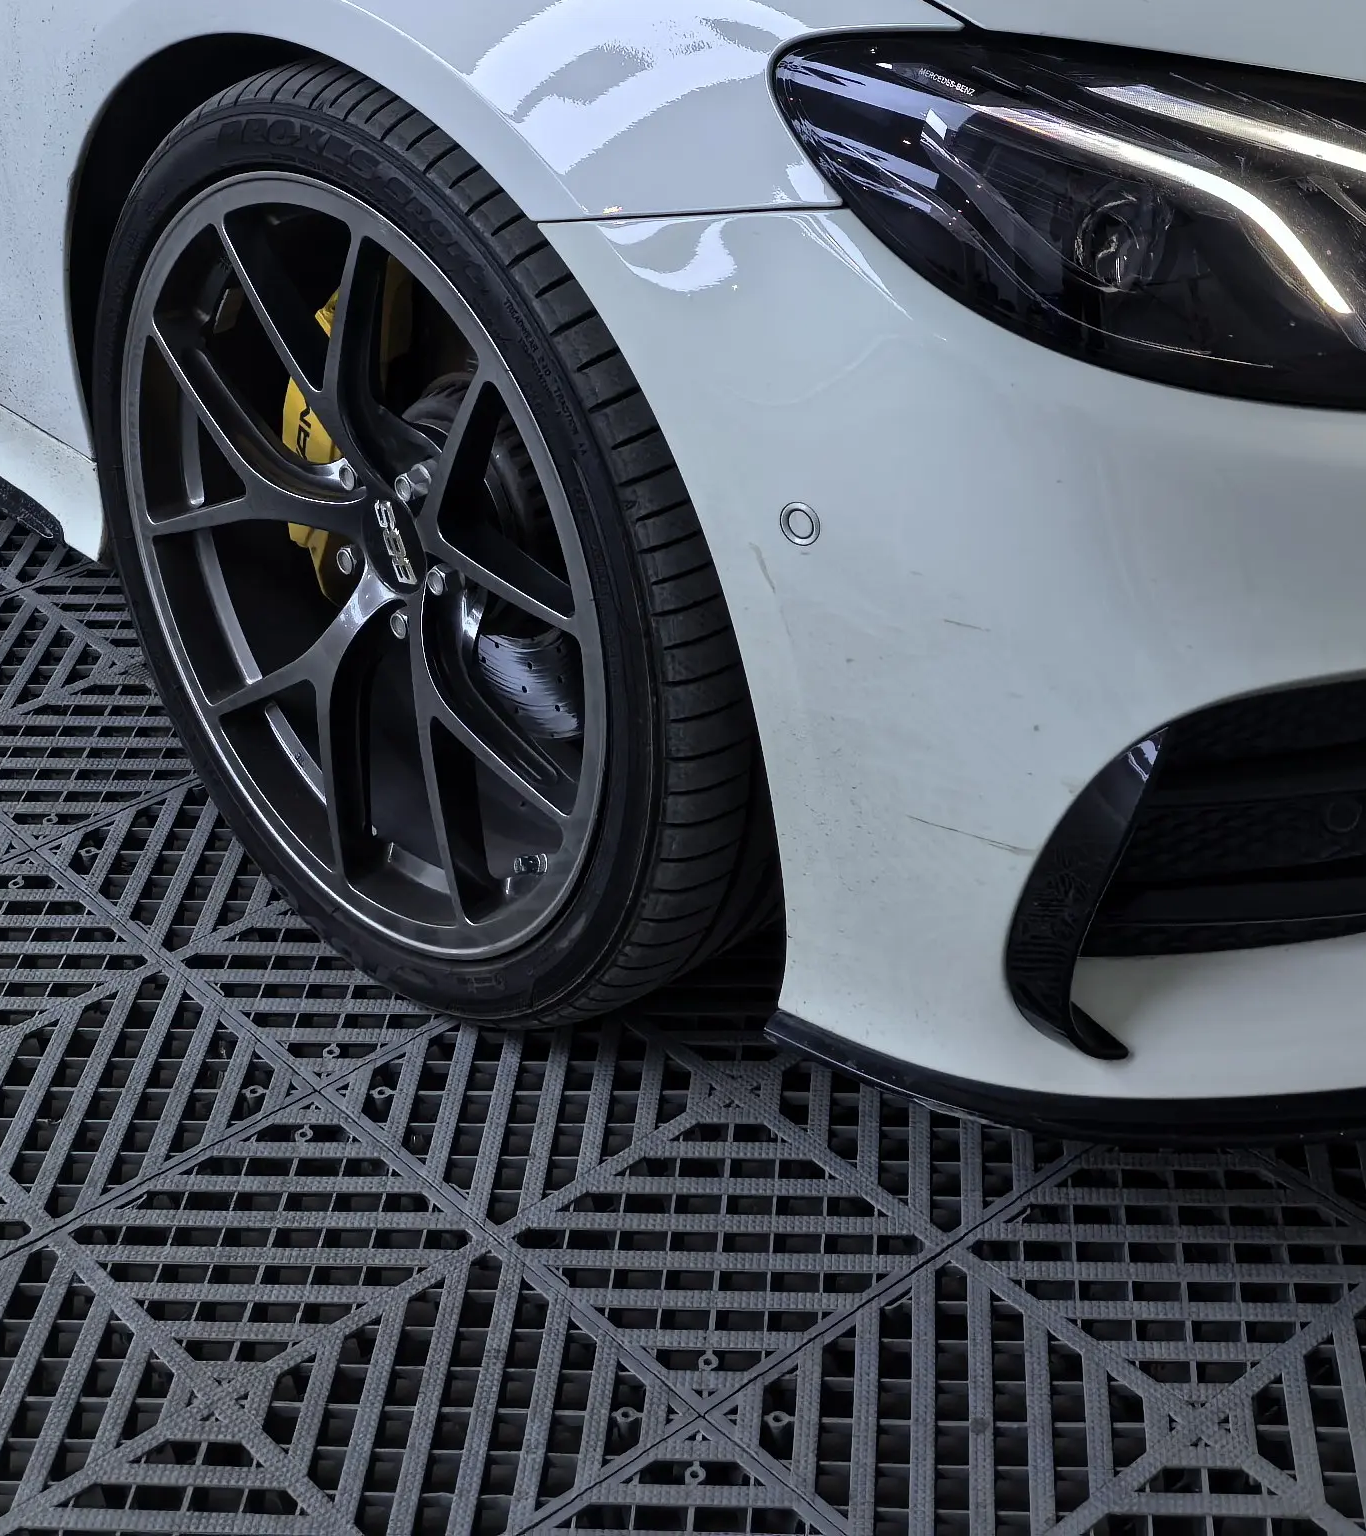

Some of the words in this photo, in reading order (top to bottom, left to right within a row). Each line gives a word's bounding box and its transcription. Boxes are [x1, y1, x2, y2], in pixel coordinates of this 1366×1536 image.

[918, 67, 976, 96] MERCEDES-BENZ
[217, 118, 383, 181] PROXES
[373, 498, 418, 586] BBS
